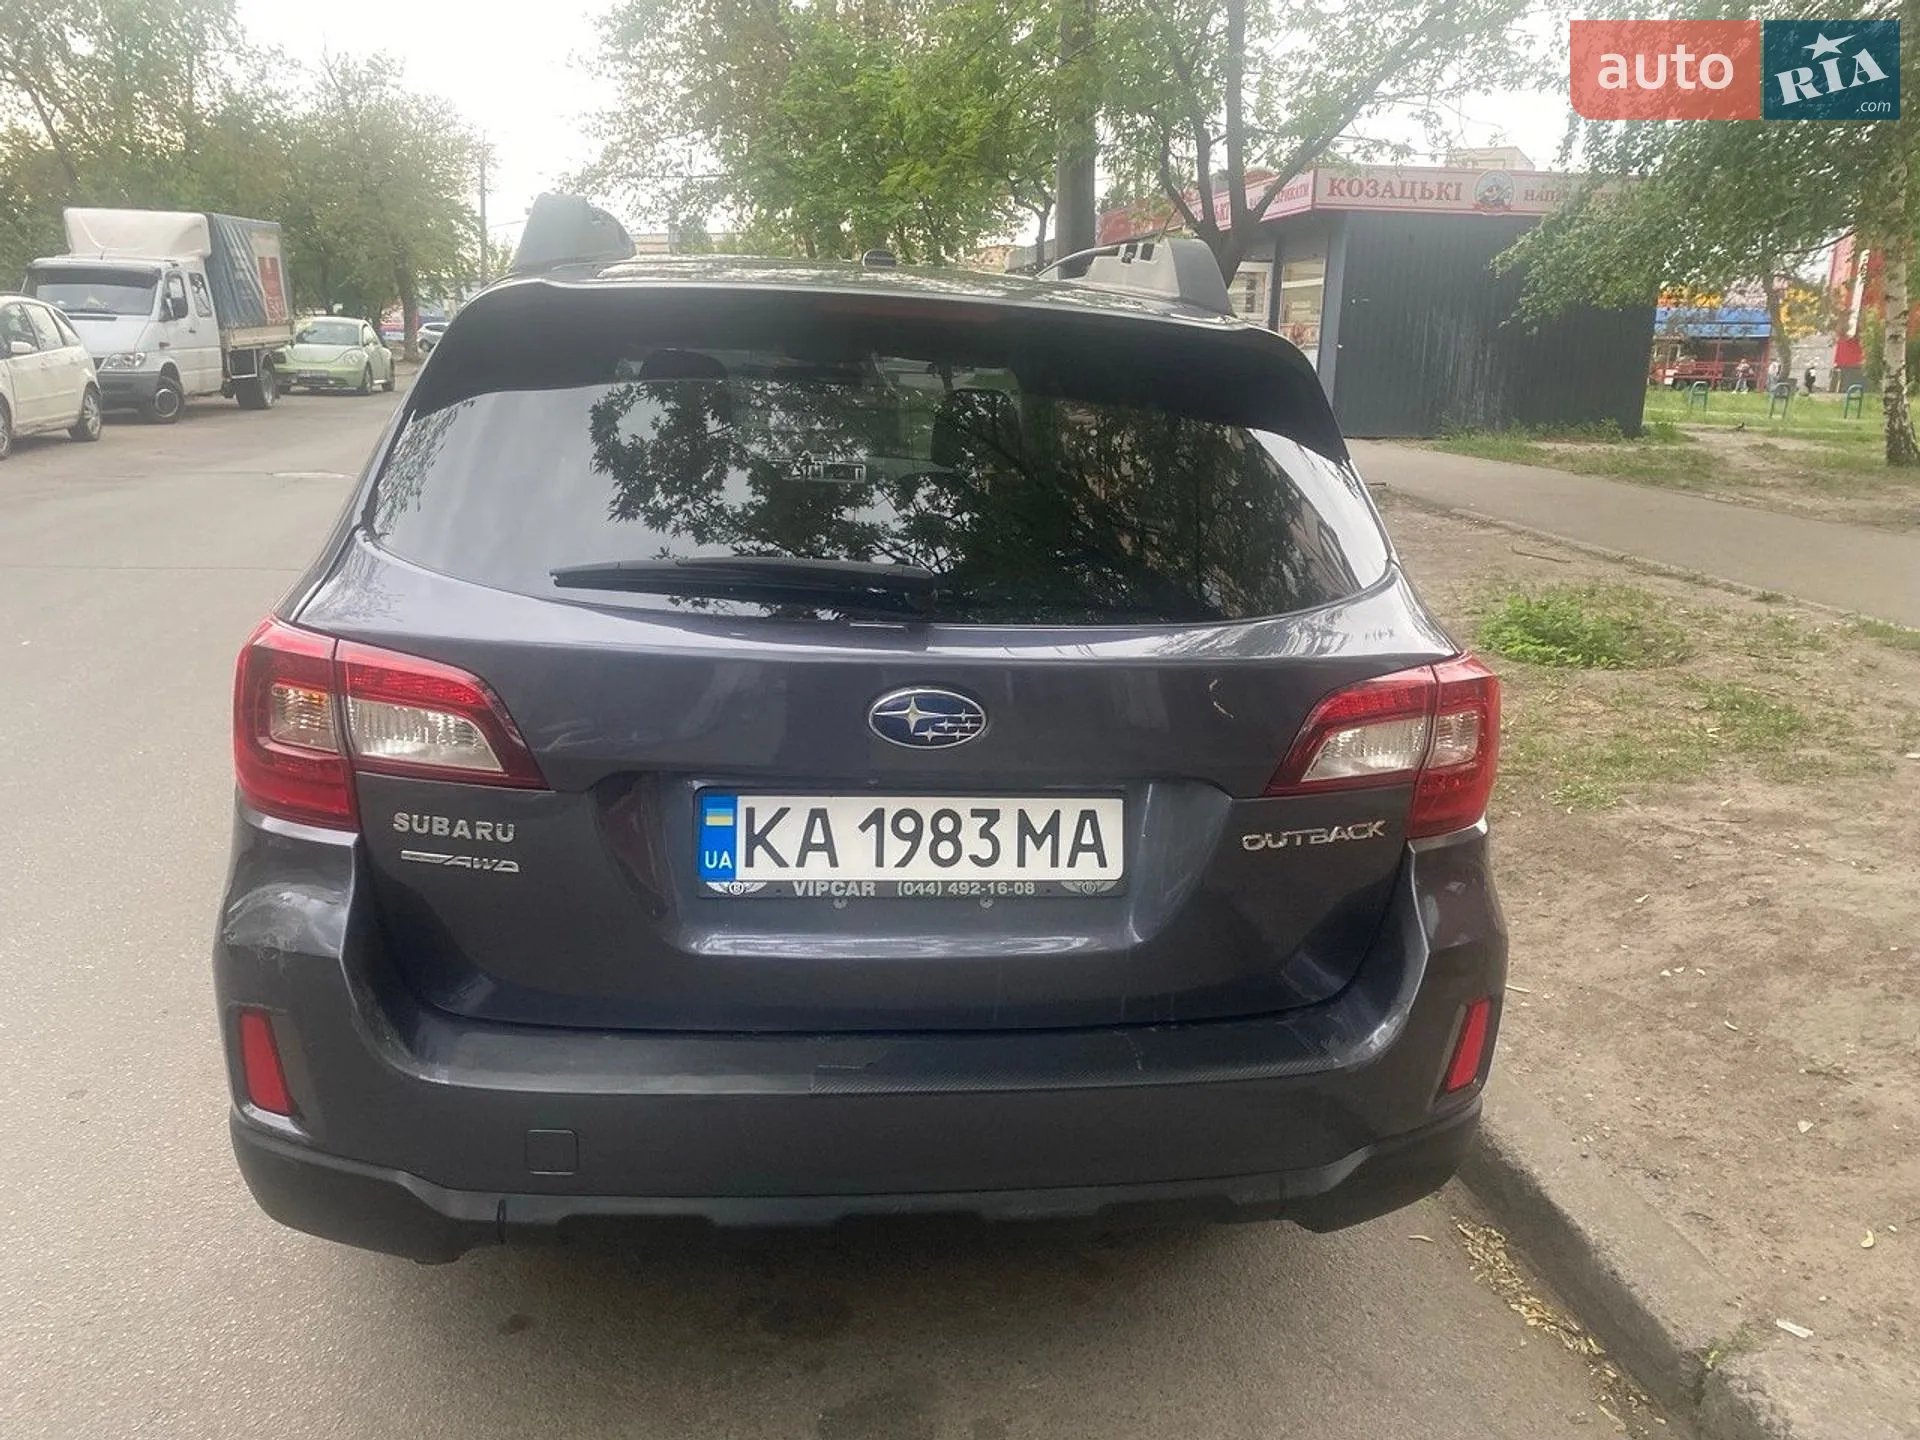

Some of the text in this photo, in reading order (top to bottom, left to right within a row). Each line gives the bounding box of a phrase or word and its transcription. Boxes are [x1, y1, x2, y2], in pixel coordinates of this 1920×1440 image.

[1327, 177, 1463, 202] КОЗАЦЬКІ
[393, 812, 515, 842] SUBARU
[744, 807, 1108, 869] KA 1983 MA
[1242, 820, 1386, 850] OUTBACK
[444, 855, 520, 873] AWD
[705, 850, 733, 869] UA
[793, 880, 1036, 897] VIPCAR (044) 492-16-08
